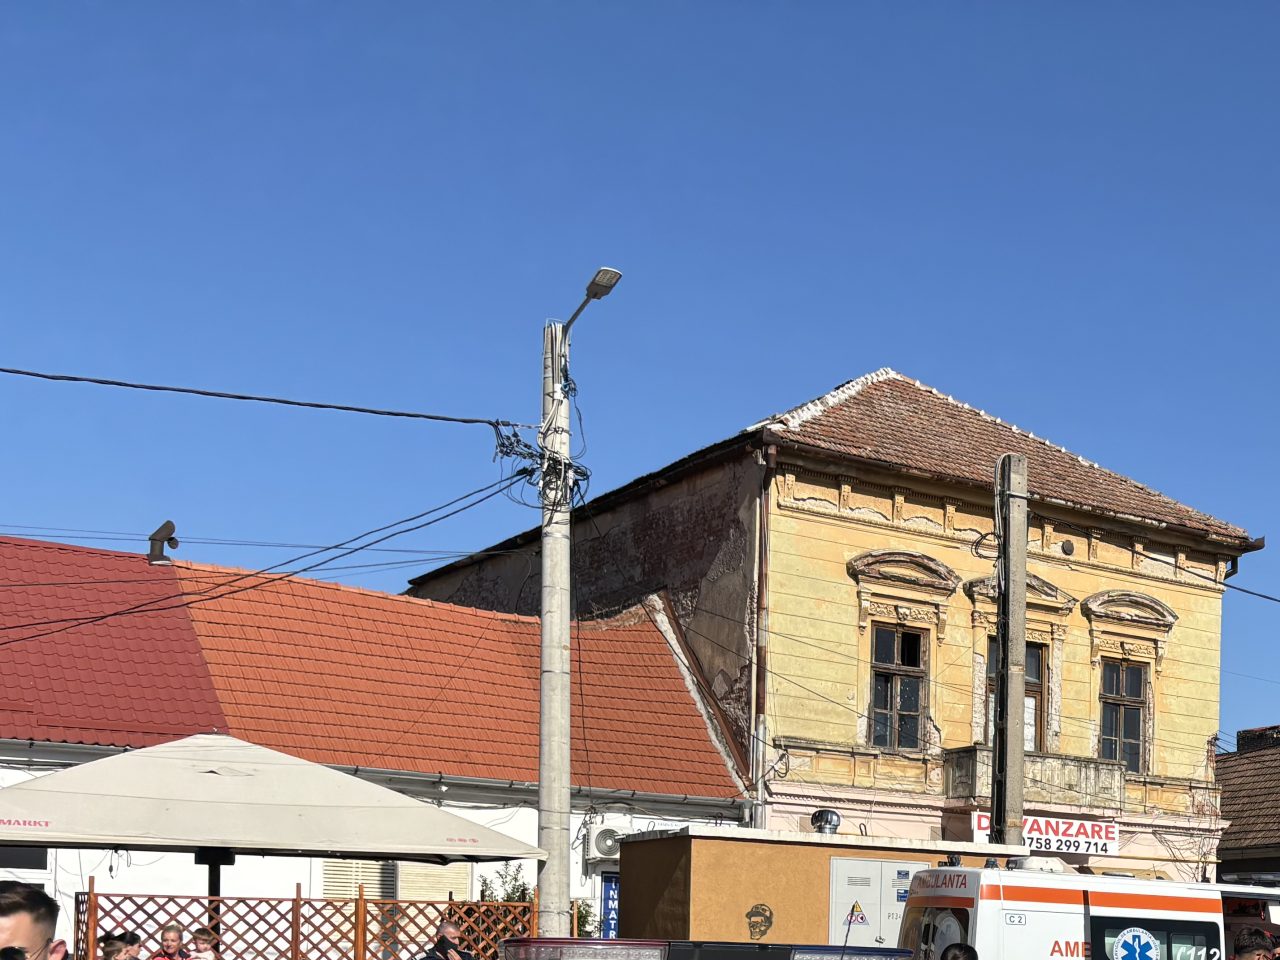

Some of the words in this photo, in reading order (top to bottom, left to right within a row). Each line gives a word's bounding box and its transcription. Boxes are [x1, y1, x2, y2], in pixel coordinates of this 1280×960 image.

[1056, 839, 1081, 852] 299
[1085, 841, 1109, 854] 714
[1009, 915, 1015, 924] C
[1018, 915, 1023, 924] 2
